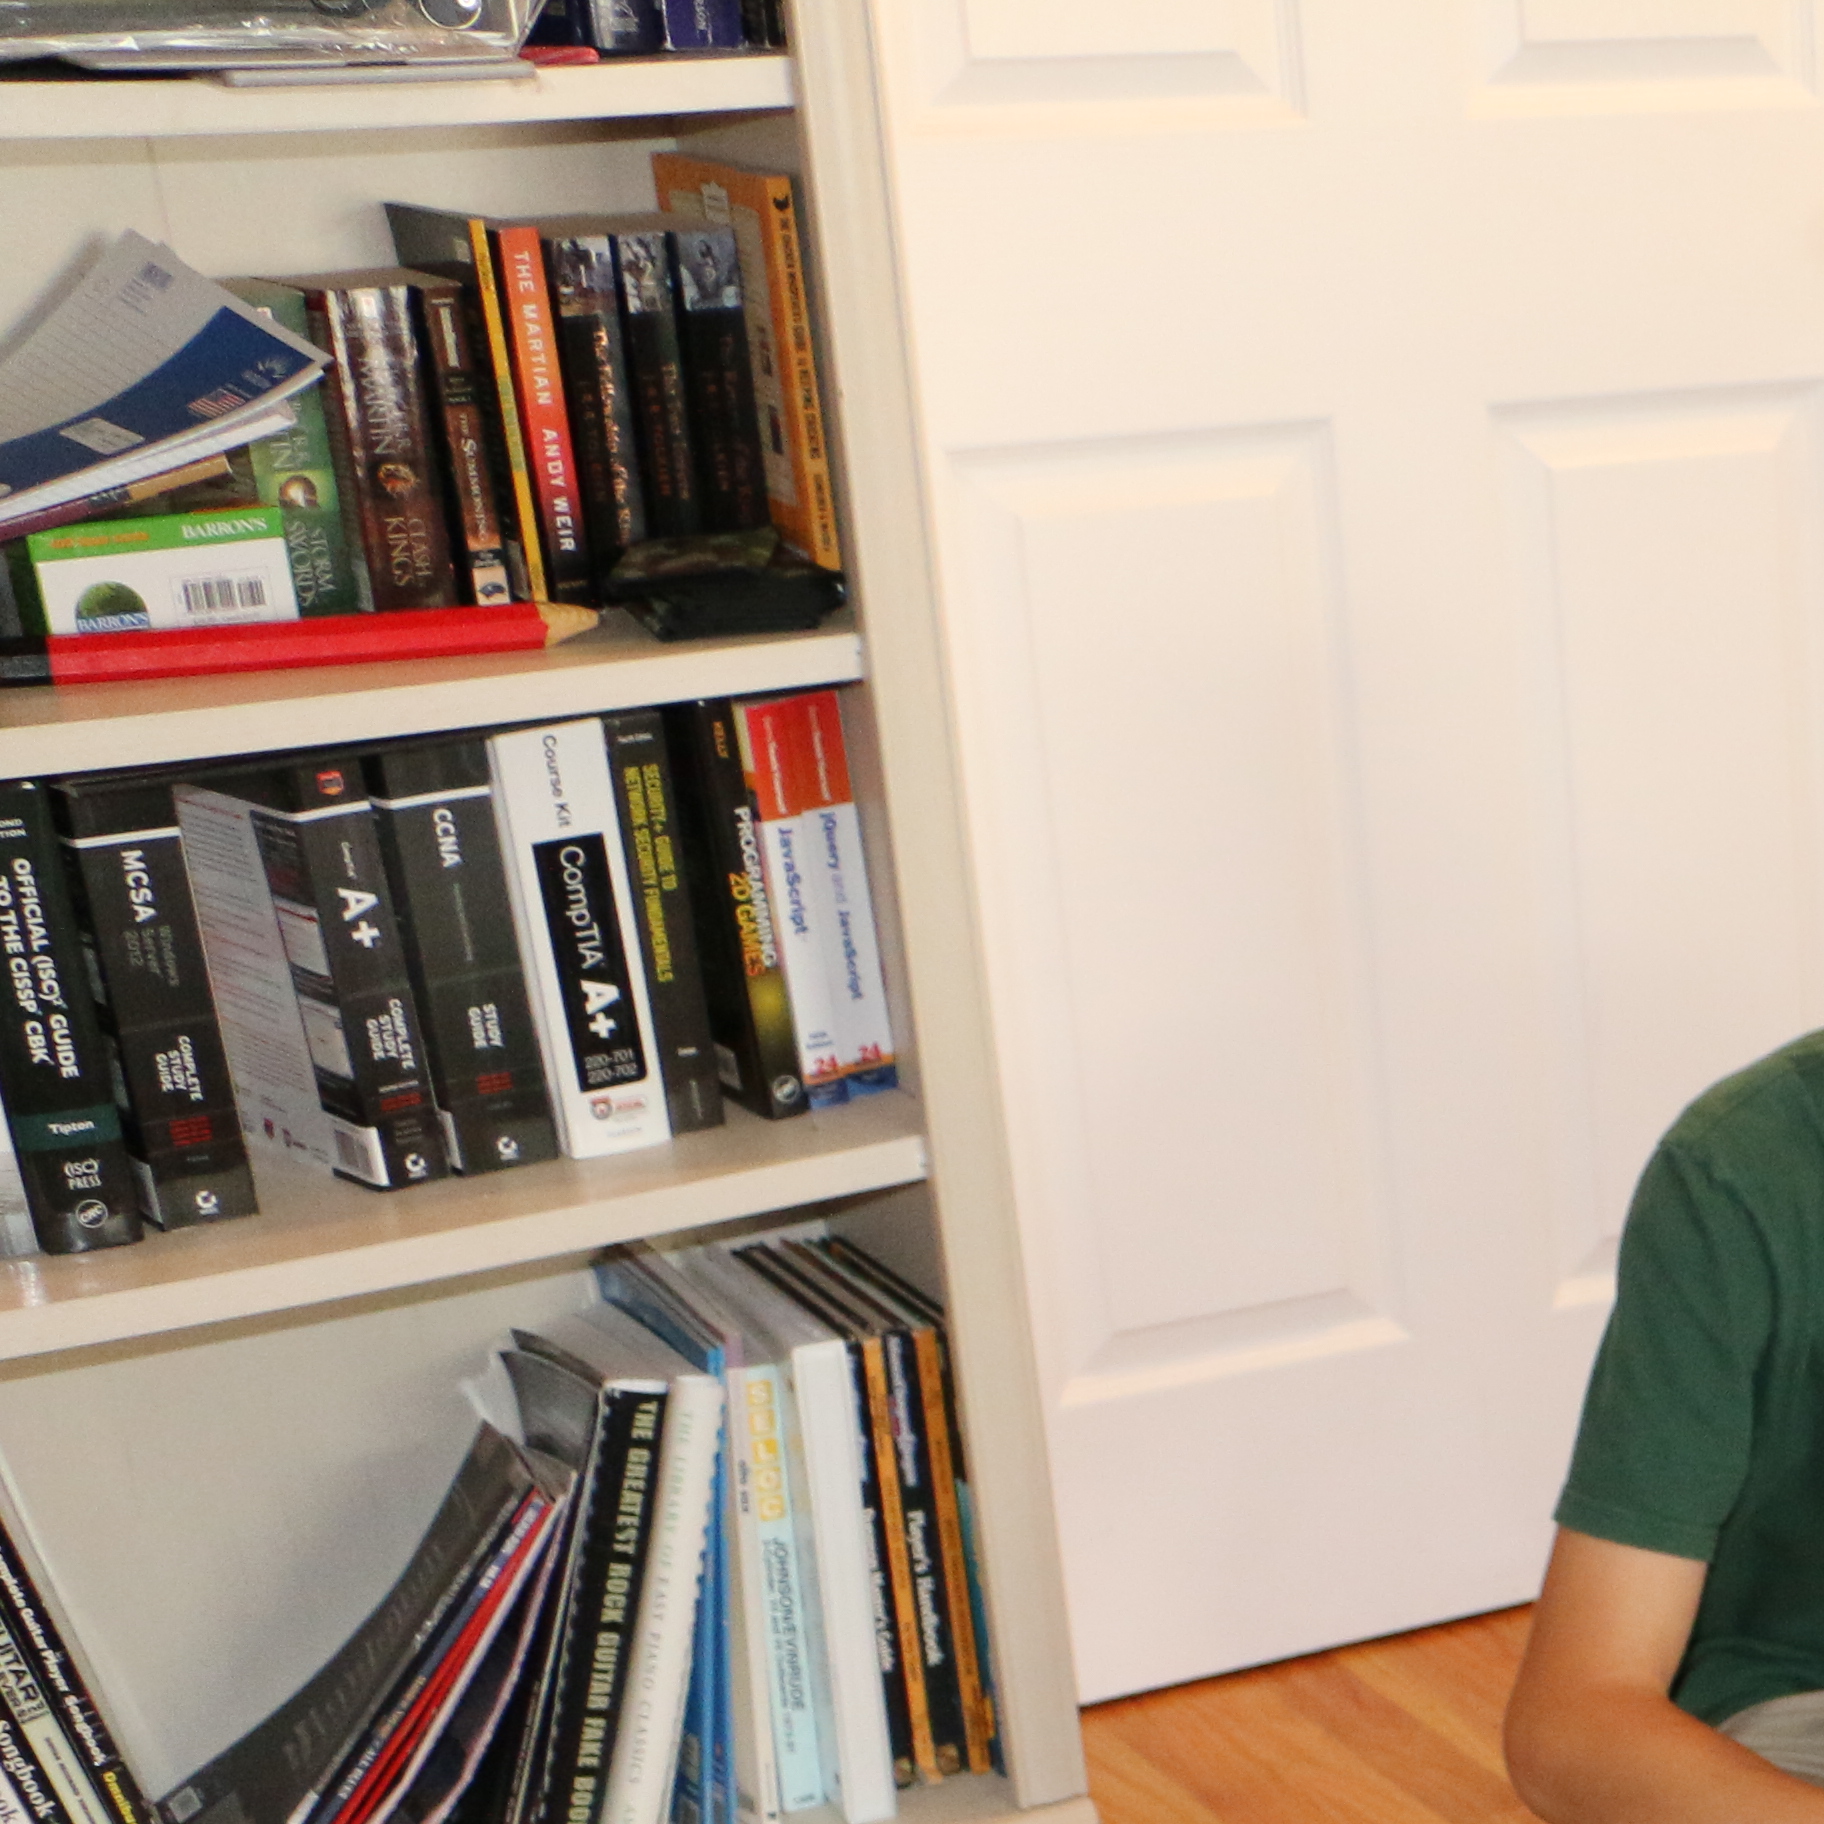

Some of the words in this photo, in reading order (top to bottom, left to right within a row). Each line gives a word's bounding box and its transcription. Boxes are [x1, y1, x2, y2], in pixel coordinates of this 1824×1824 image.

[513, 250, 534, 293] THE
[521, 303, 553, 407] MARTIAN
[542, 427, 566, 489] ANDY
[181, 517, 267, 539] BARRON'S
[384, 517, 413, 588] KINGS
[552, 495, 577, 554] WEIR
[541, 734, 564, 798] Course
[554, 801, 573, 828] Kit
[431, 806, 462, 869] CCNA
[120, 849, 157, 923] MCSA
[728, 870, 749, 899] 2D
[733, 804, 777, 968] PROGRAMMING
[776, 826, 808, 935] JavaScript
[819, 811, 841, 869] jQuery
[838, 909, 865, 1001] JavaScript
[1, 911, 26, 954] THE
[336, 886, 381, 949] A+
[734, 903, 766, 977] GAMES
[12, 857, 51, 953] OFFICIAL
[49, 1011, 80, 1079] GUIDE
[377, 1012, 399, 1060] STUDY
[388, 998, 417, 1071] COMPLETE
[467, 1006, 487, 1050] GUIDE
[481, 1002, 505, 1049] STUDY
[580, 977, 621, 1040] A+
[167, 1048, 186, 1091] STUDY
[179, 1034, 204, 1101] COMPLETE
[366, 1017, 389, 1063] GUIDE
[584, 1047, 634, 1069] 220-701
[815, 1055, 839, 1074] 24
[858, 1045, 881, 1064] 24
[154, 1052, 174, 1092] GUIDE
[586, 1061, 639, 1084] 220-702
[48, 1120, 96, 1136] Tipton
[67, 1174, 102, 1191] PRESS
[79, 1205, 104, 1223] CRC
[629, 1398, 659, 1441] THE
[609, 1446, 651, 1556] GREATEST
[907, 1509, 930, 1571] Player's
[597, 1560, 632, 1625] ROCK
[649, 1575, 672, 1622] EASY
[915, 1570, 945, 1667] Handbook
[19, 1606, 50, 1654] Guitar
[39, 1645, 71, 1693] Player
[62, 1694, 106, 1767] Songbook
[584, 1629, 620, 1712] GUITAR
[639, 1630, 663, 1691] PIANO
[0, 1720, 54, 1820] Songbook
[574, 1715, 606, 1770] FAKE
[624, 1699, 654, 1785] CLASSICS
